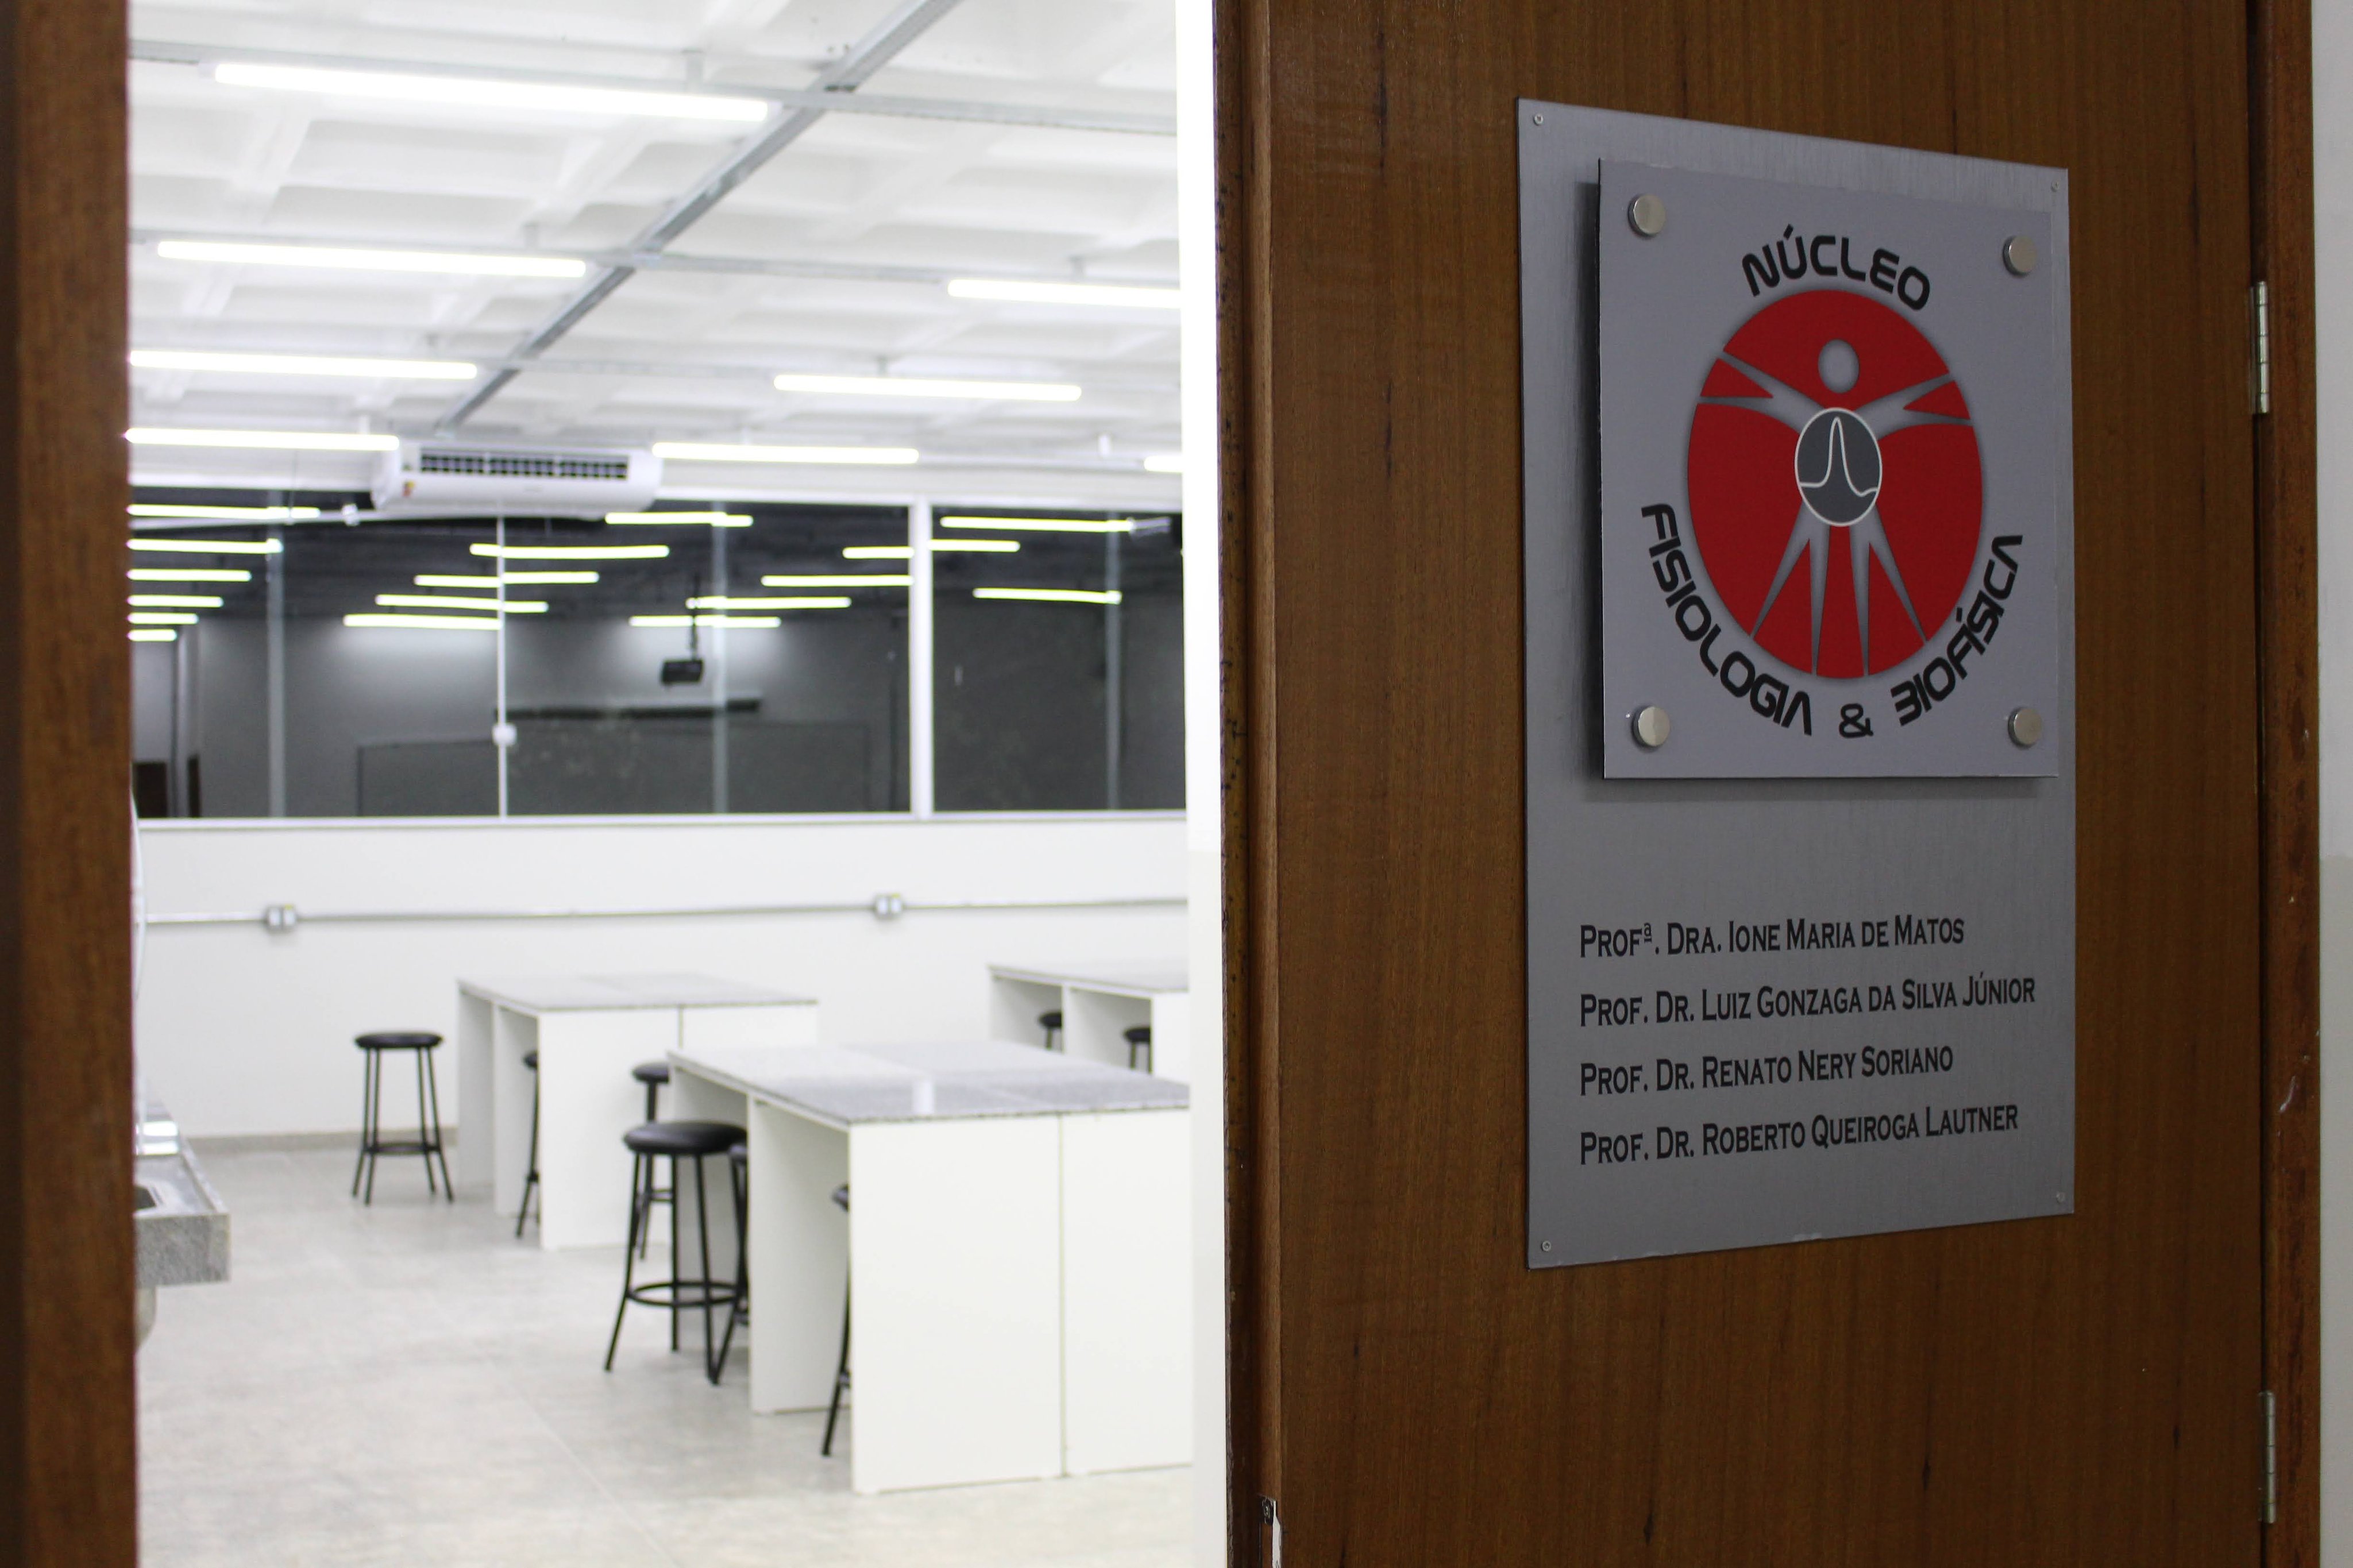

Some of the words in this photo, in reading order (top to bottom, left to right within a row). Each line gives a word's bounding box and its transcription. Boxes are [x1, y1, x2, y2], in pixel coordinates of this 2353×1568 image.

[1742, 224, 1930, 311] NÚCLEO
[1641, 503, 1812, 736] FISIOLOGIA
[1839, 703, 1874, 739] &
[1668, 922, 1722, 954] DRA.
[1729, 920, 1781, 953] IONE
[1787, 918, 1856, 951] MARIA
[1861, 920, 1889, 948] DE
[1894, 914, 1965, 946] MATOS
[1580, 994, 1648, 1027] PROF.
[1656, 990, 1695, 1024] DR.
[1702, 988, 1752, 1021] LUIZ
[1757, 985, 1863, 1018] GONZAGA
[1868, 984, 1897, 1012] DA
[1902, 978, 1958, 1010] SILVA
[1962, 971, 2036, 1007] JÚNIOR
[1580, 1063, 1648, 1096] PROF.
[1656, 1058, 1695, 1092] DR.
[1702, 1056, 1792, 1088] RENATO
[1797, 1049, 1857, 1082] NERY
[1861, 1045, 1954, 1078] SORIANO
[1580, 1131, 1649, 1165] PROF.
[1656, 1126, 1695, 1160] DR.
[1702, 1121, 1806, 1156] ROBERTO
[1811, 1112, 1920, 1149] QUEIROGA
[1925, 1103, 2019, 1137] LAUTNER
